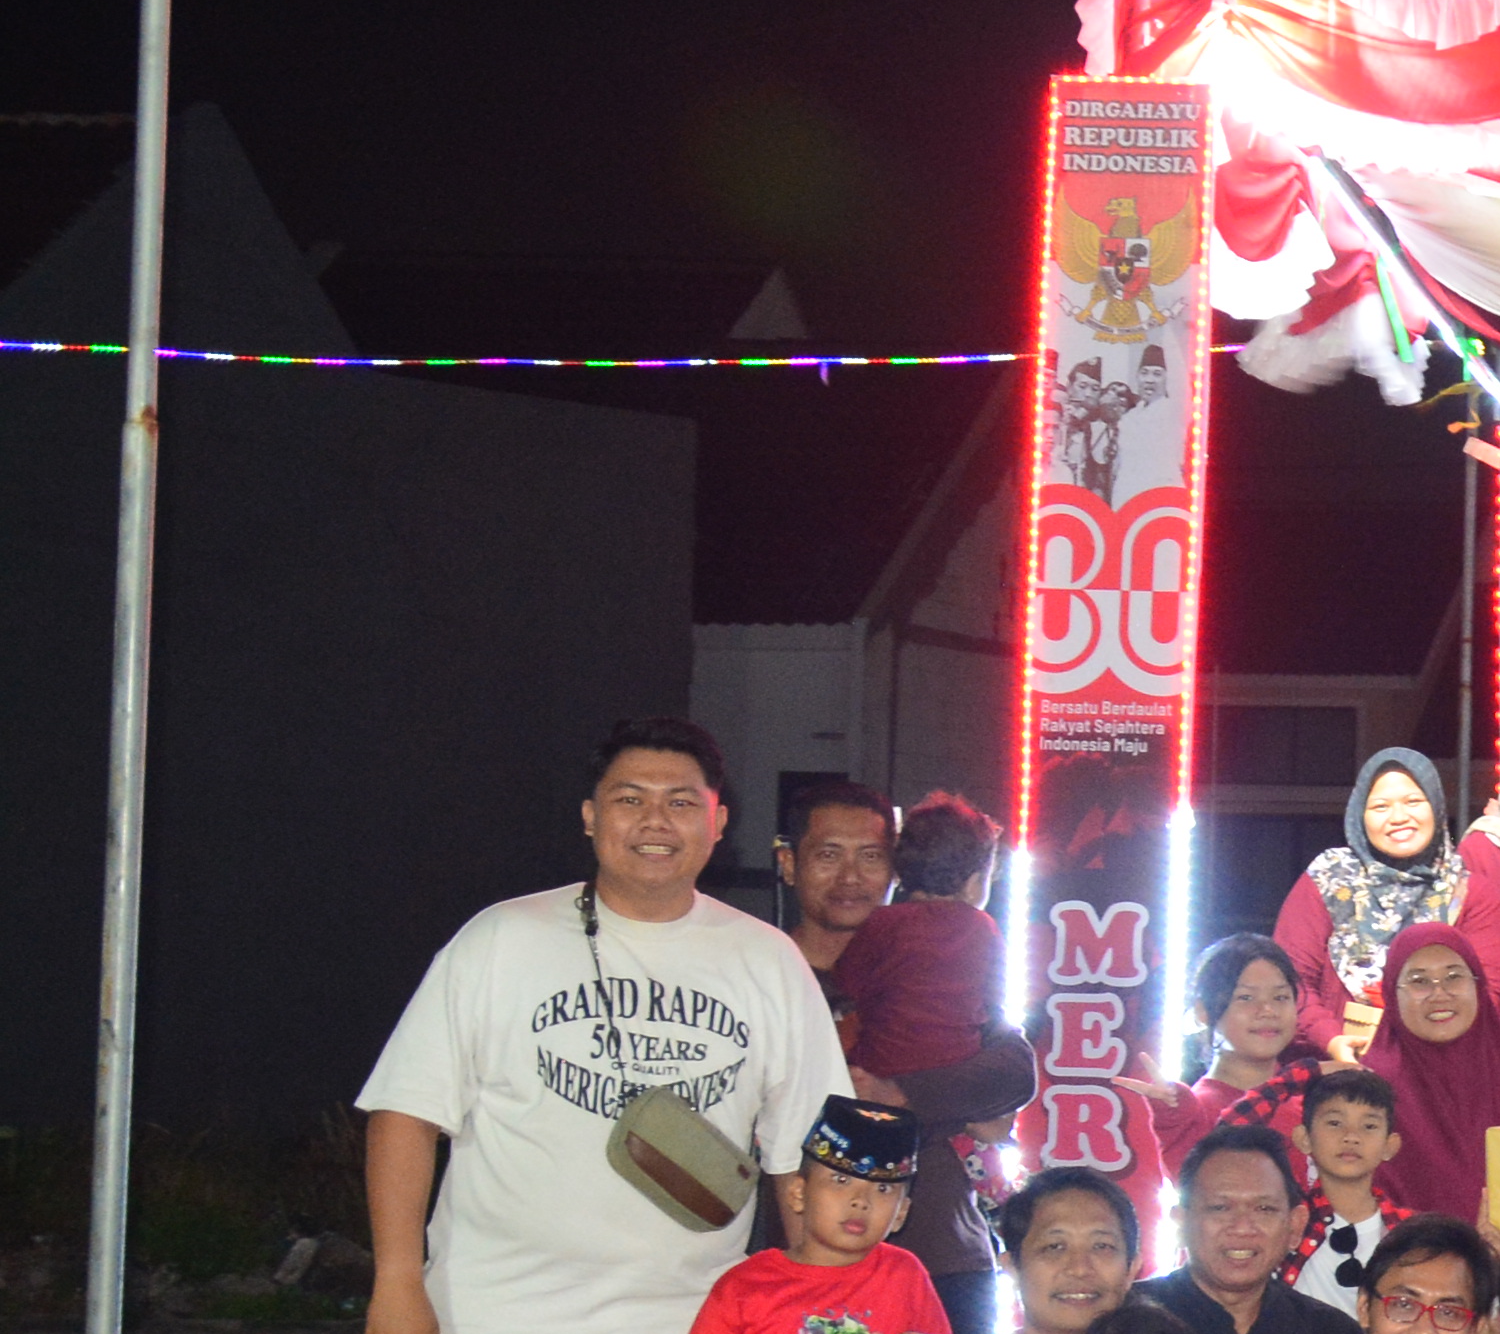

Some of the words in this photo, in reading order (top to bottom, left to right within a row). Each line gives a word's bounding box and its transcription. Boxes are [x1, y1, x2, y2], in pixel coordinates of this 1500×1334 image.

[1065, 100, 1201, 121] DIRGAHAYU
[1063, 126, 1199, 148] REPUBLIK
[1062, 153, 1198, 174] INDONESIA
[1041, 699, 1098, 715] Bersatu
[1102, 700, 1172, 716] Berdaulat
[1040, 718, 1091, 735] Rakyat
[1094, 719, 1165, 737] Sejahtera
[1039, 737, 1111, 752] Indonesia
[1114, 738, 1148, 755] Maju
[532, 977, 638, 1033] GRAND
[646, 977, 750, 1049] RAPIDS
[590, 1023, 621, 1060] 50
[628, 1032, 708, 1061] YEARS
[611, 1061, 627, 1071] OF
[632, 1063, 680, 1075] QUALITY
